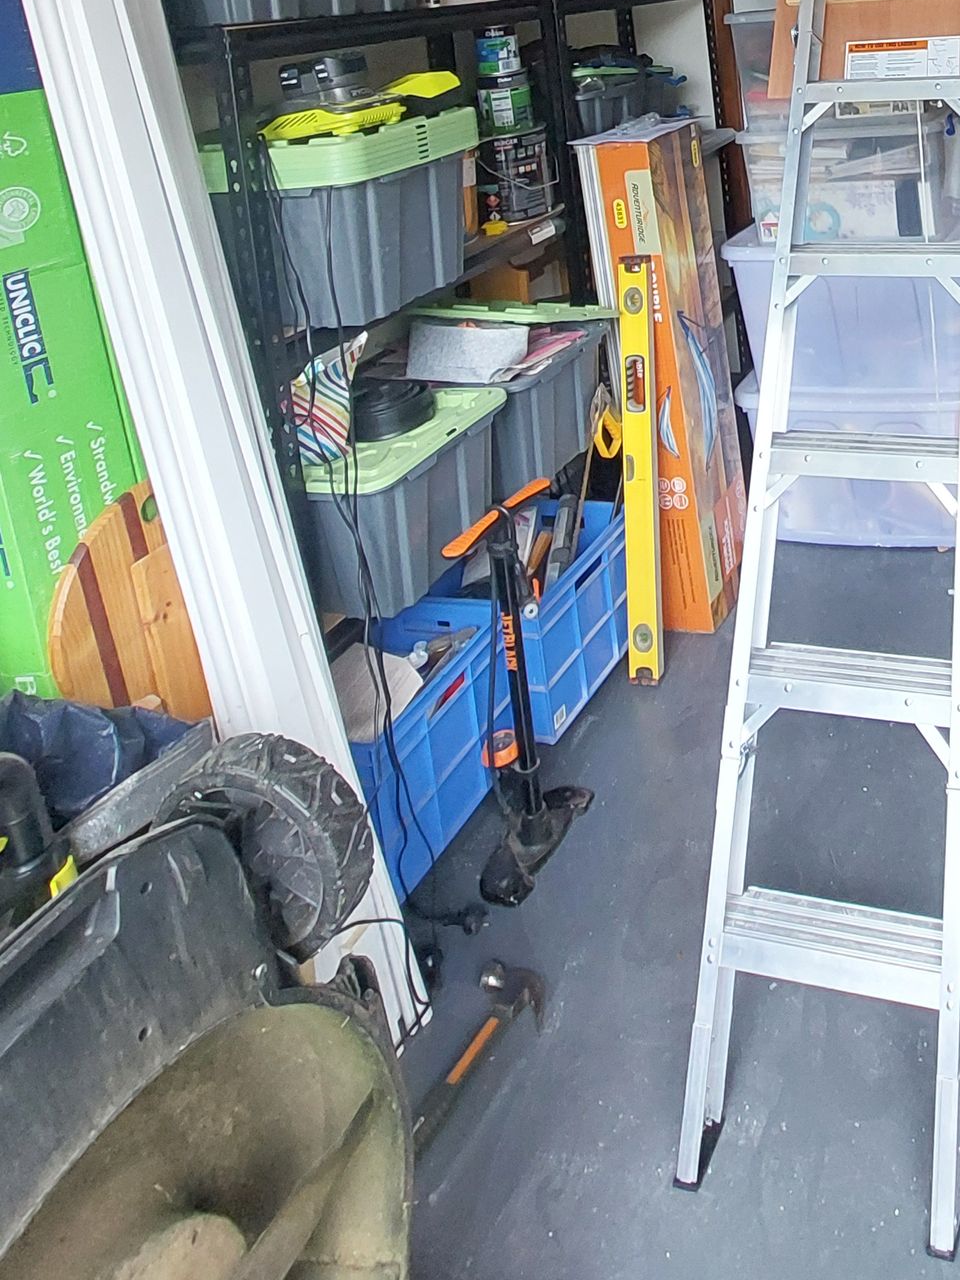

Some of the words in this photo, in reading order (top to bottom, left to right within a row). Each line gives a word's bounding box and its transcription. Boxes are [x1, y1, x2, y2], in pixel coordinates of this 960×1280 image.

[631, 182, 646, 244] ADVENTURIDGE
[6, 273, 42, 358] UNICLIC
[27, 464, 57, 536] World's
